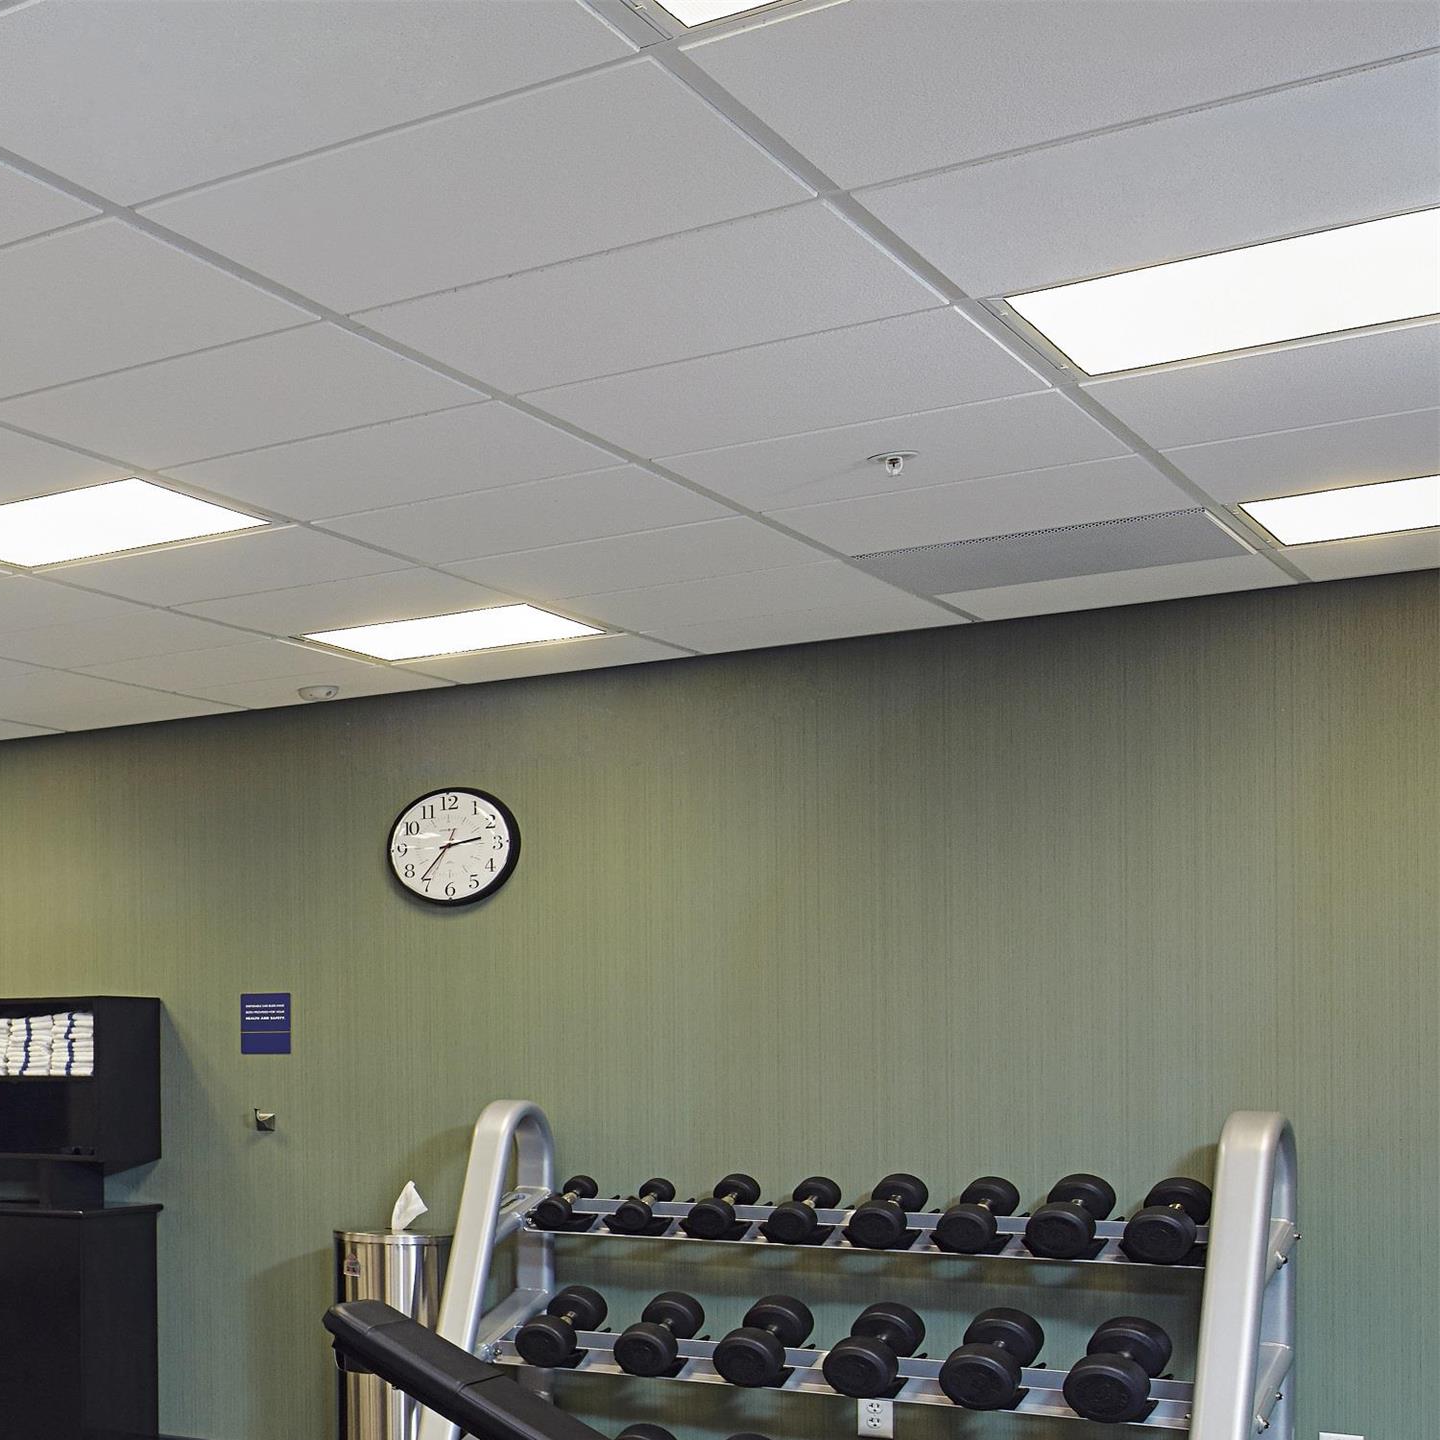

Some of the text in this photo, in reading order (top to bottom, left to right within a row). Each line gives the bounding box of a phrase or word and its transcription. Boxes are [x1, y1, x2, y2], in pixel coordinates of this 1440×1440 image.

[440, 796, 458, 810] 12
[472, 801, 477, 815] 1
[422, 805, 436, 819] 11
[405, 821, 419, 835] 10
[485, 814, 496, 829] 2
[493, 835, 503, 849] 3
[397, 843, 407, 857] 9
[405, 864, 415, 878] 8
[485, 858, 496, 872] 4
[422, 879, 431, 892] 7
[469, 874, 479, 888] 5
[445, 882, 455, 896] 6
